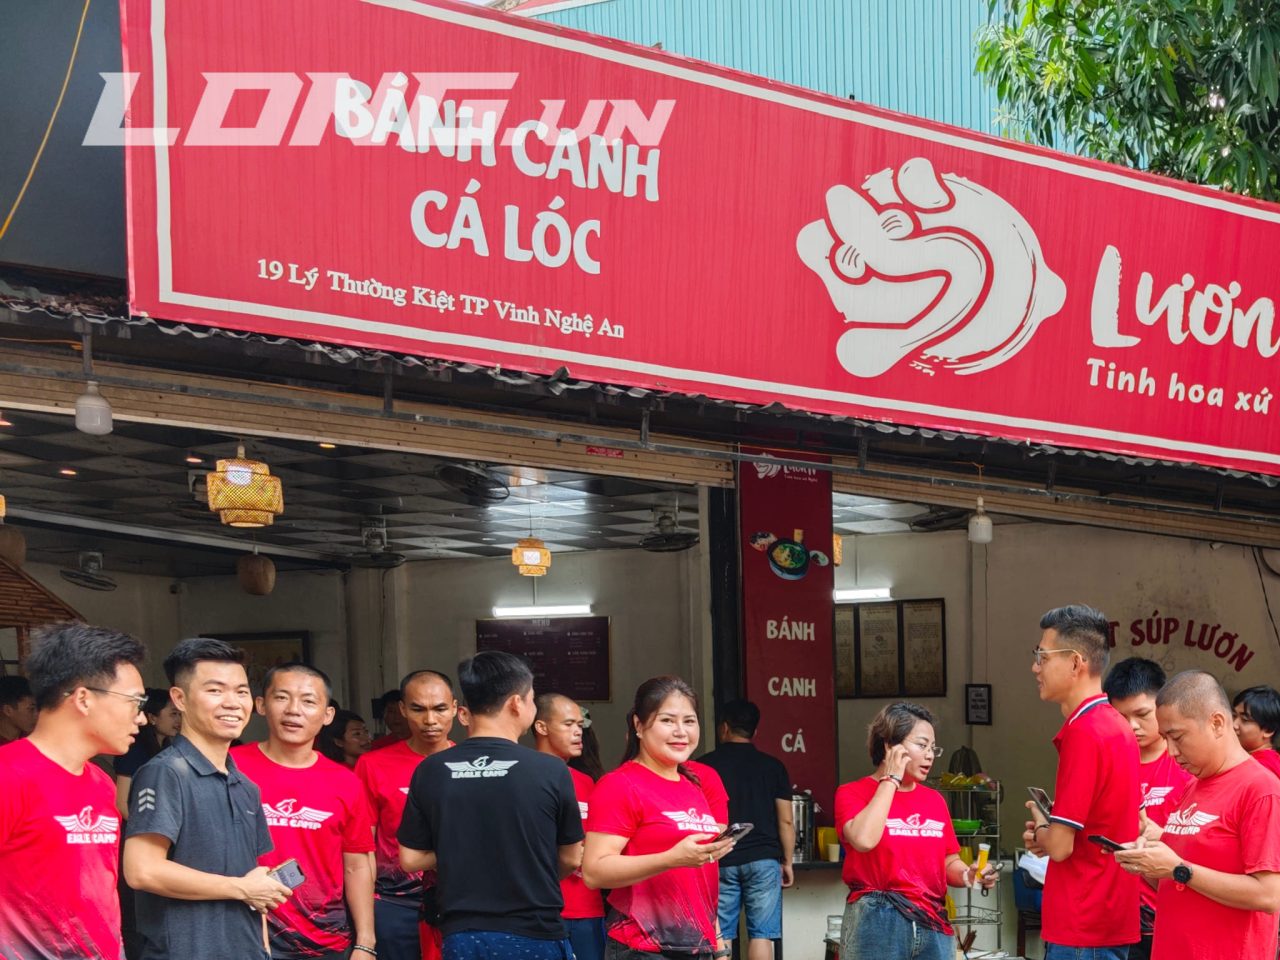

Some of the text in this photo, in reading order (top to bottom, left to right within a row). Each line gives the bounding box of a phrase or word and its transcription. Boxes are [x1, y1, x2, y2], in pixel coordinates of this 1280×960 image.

[335, 72, 660, 201] BÁNH CANH
[410, 178, 601, 275] CÁ LÓC
[256, 258, 625, 339] 19 Lý Thường Kiệt TP Vinh Nghệ An
[1086, 357, 1156, 396] Tinh
[1168, 372, 1224, 408] hoa
[1234, 386, 1273, 415] xứ
[766, 615, 816, 641] BÁNH
[1130, 610, 1180, 647] SÚP
[1183, 619, 1255, 673] LƯƠN
[767, 676, 817, 697] CANH
[781, 727, 807, 753] CÁ
